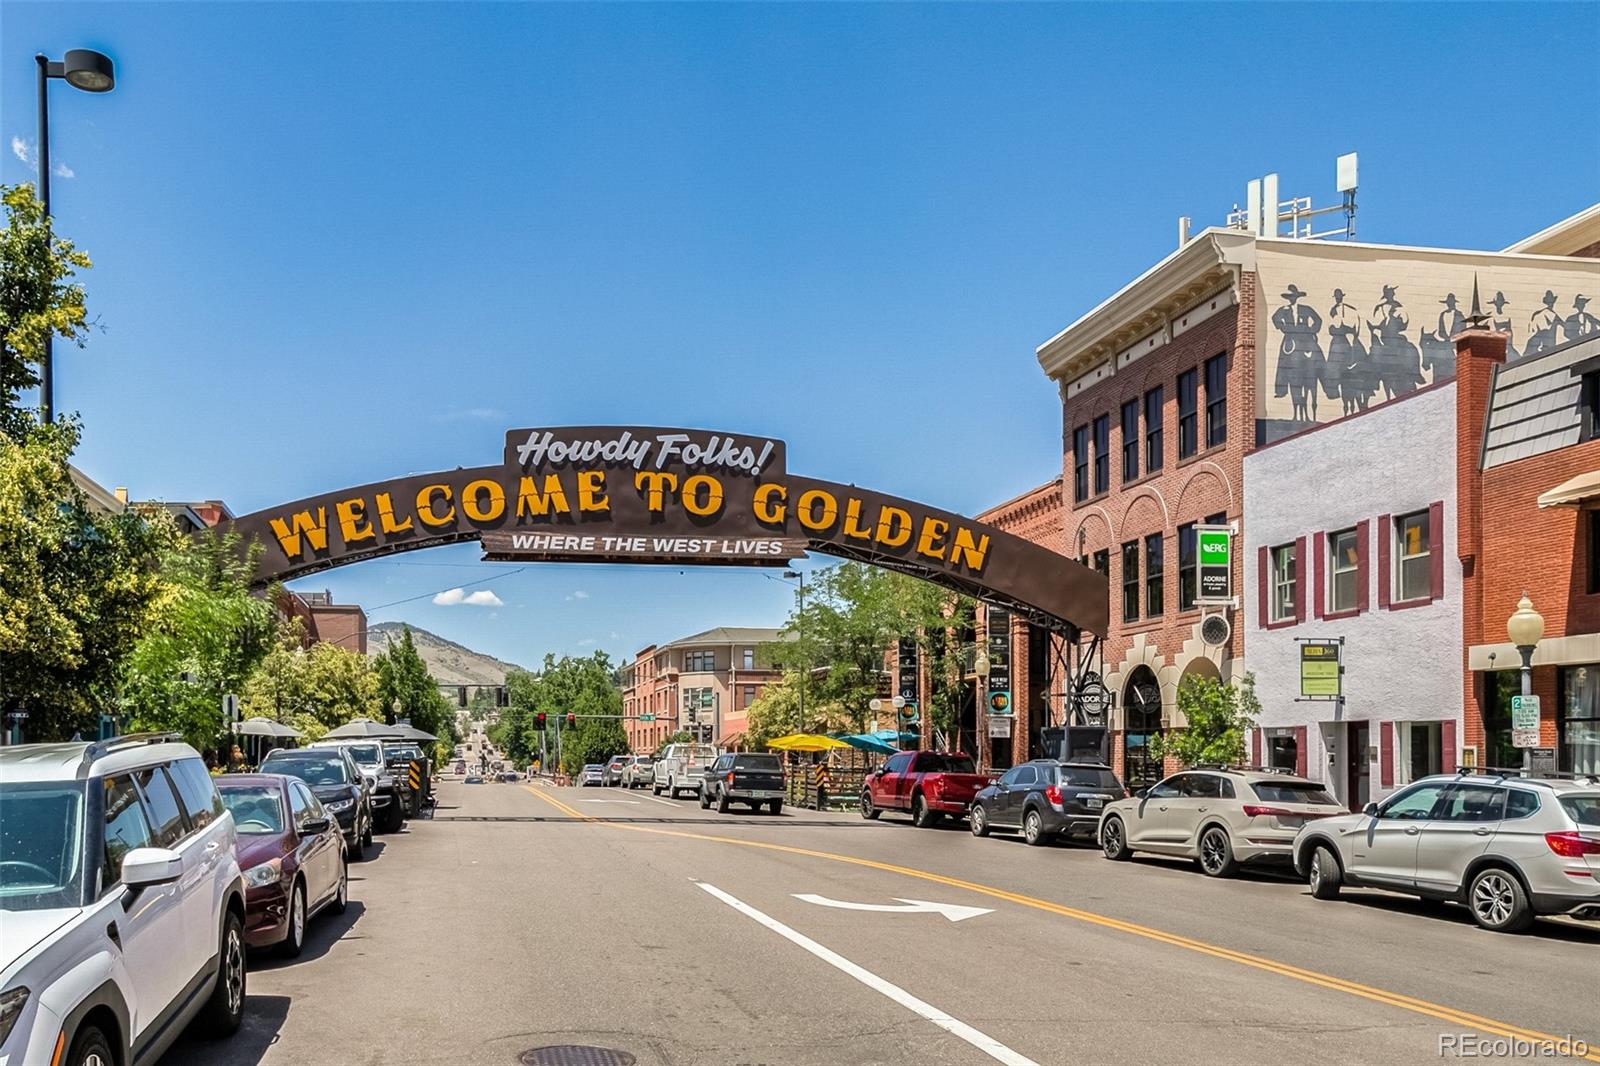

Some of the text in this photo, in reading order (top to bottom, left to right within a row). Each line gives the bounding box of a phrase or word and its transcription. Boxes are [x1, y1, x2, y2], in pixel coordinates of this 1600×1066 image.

[517, 431, 774, 476] Howdy Folks!
[269, 471, 990, 571] WELCOME TO GOLDEN
[512, 535, 783, 555] WHERE THE WEST LIVES
[1210, 543, 1226, 552] ERG
[1514, 699, 1520, 708] 2
